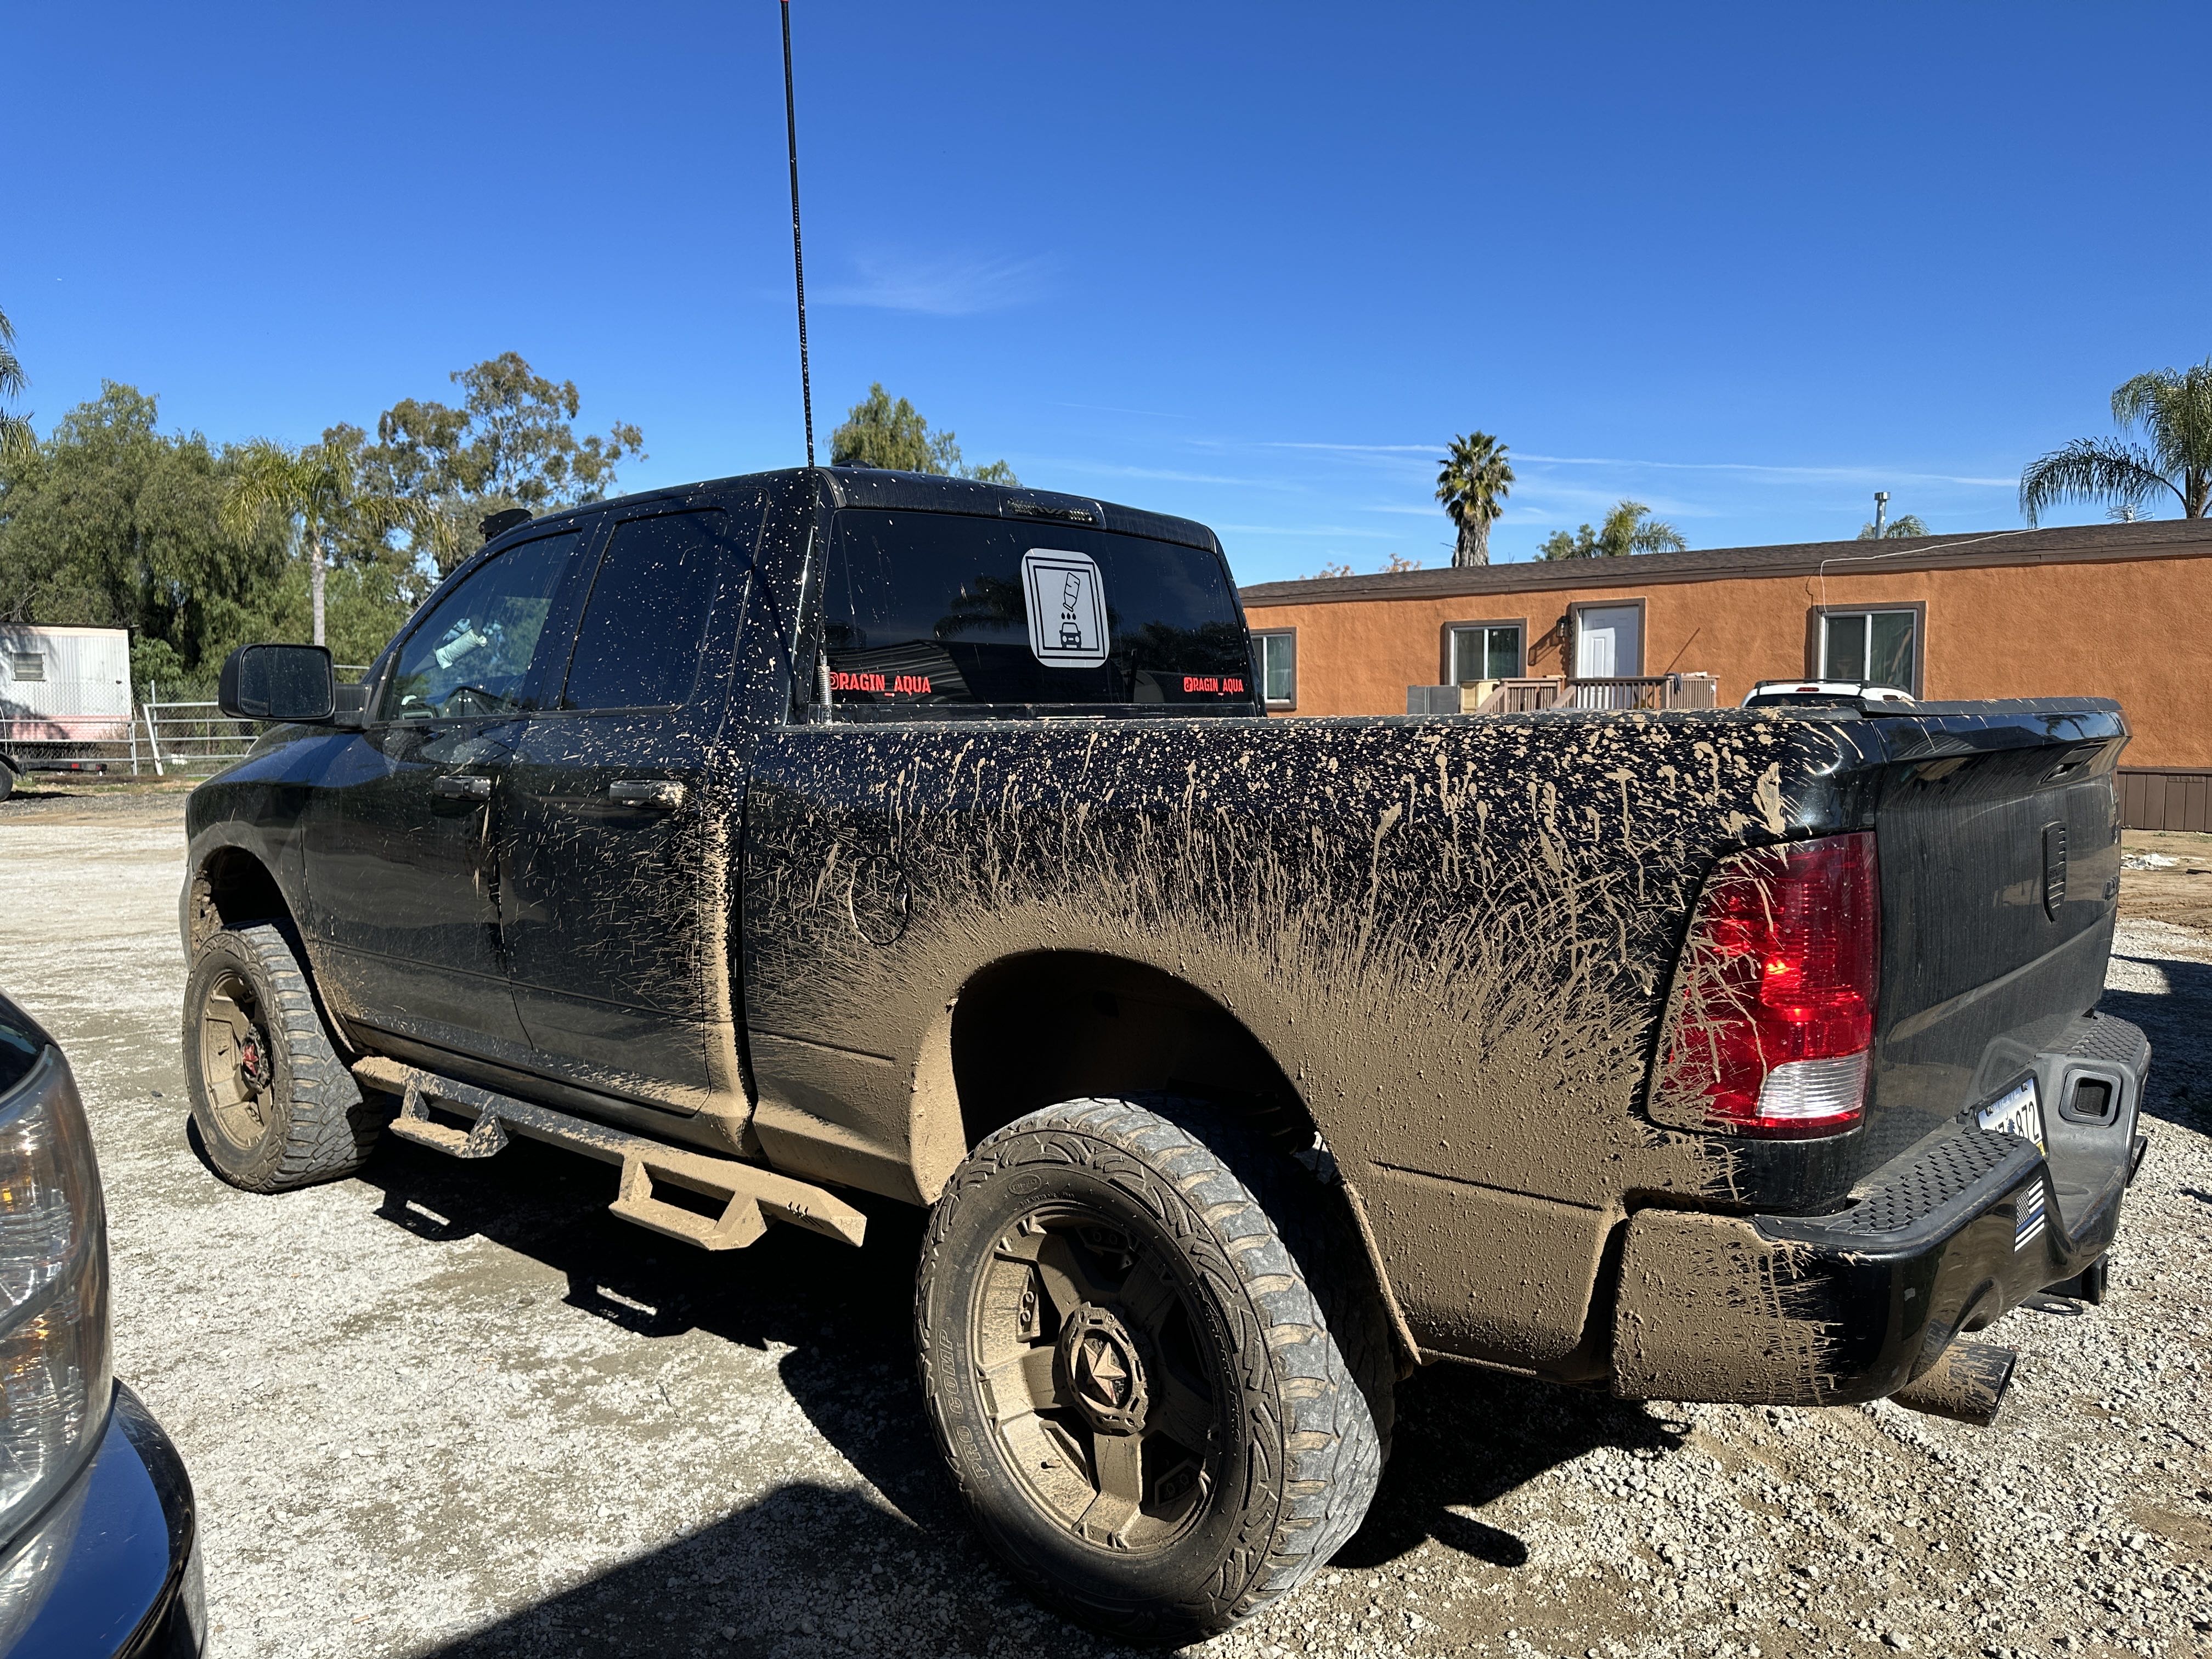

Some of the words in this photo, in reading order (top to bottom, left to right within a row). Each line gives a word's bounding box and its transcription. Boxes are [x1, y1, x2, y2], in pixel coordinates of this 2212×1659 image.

[2016, 1101, 2039, 1141] 872
[939, 1329, 964, 1415] COMP
[956, 1425, 991, 1479] PRO
